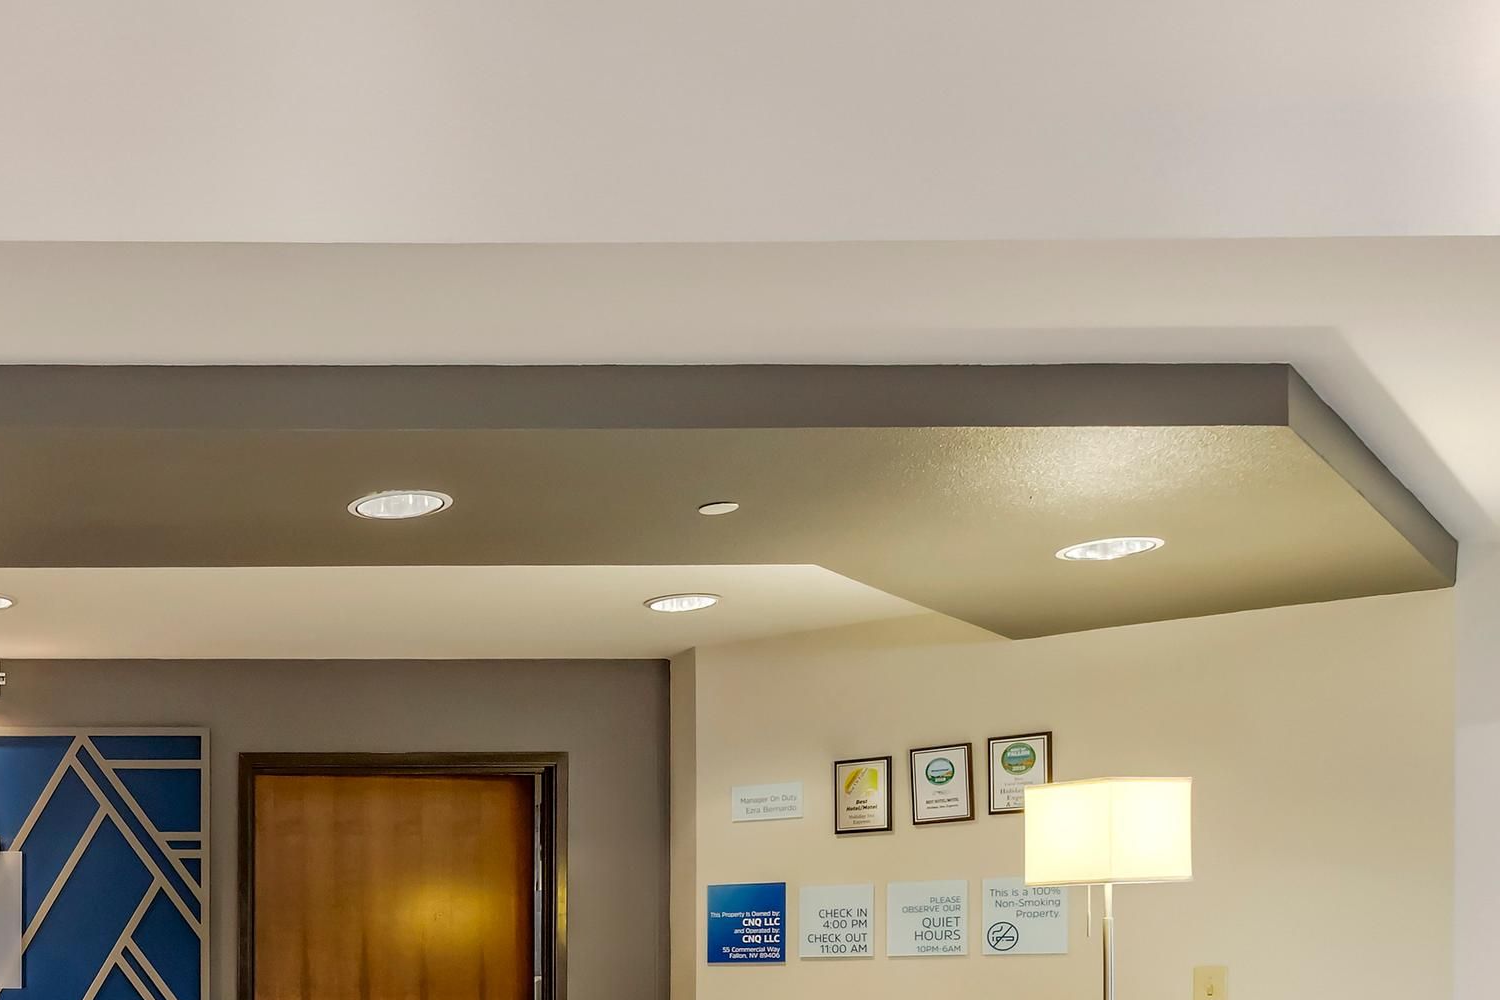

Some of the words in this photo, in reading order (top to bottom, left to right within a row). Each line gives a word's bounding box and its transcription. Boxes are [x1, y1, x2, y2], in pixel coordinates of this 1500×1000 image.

[740, 796, 768, 805] Manager
[770, 794, 780, 802] On
[781, 794, 797, 803] Duty
[745, 806, 761, 815] Ezra
[762, 804, 797, 813] Bernardo
[989, 888, 1009, 897] This
[1011, 888, 1019, 897] is
[1032, 887, 1061, 896] 100%
[929, 895, 962, 904] PLEASE
[995, 899, 1061, 908] Non-Smoking
[818, 908, 853, 919] CHECK
[856, 908, 868, 917] IN
[901, 905, 940, 914] OBSERVE
[942, 904, 962, 912] OUR
[1016, 909, 1061, 919] Property.
[742, 918, 762, 927] CNQ
[764, 917, 781, 926] LLC
[822, 919, 848, 929] 4:00
[851, 919, 868, 928] PM
[922, 916, 961, 929] QUIET
[745, 927, 771, 935] Operated
[914, 929, 961, 941] HOURS
[742, 934, 762, 943] CNQ
[763, 934, 781, 943] LLC
[807, 933, 842, 943] CHECK
[845, 932, 868, 943] OUT
[819, 944, 847, 954] 11:00
[850, 944, 868, 953] AM
[916, 945, 962, 953] 10PM-6AM
[759, 951, 781, 959] 89406
